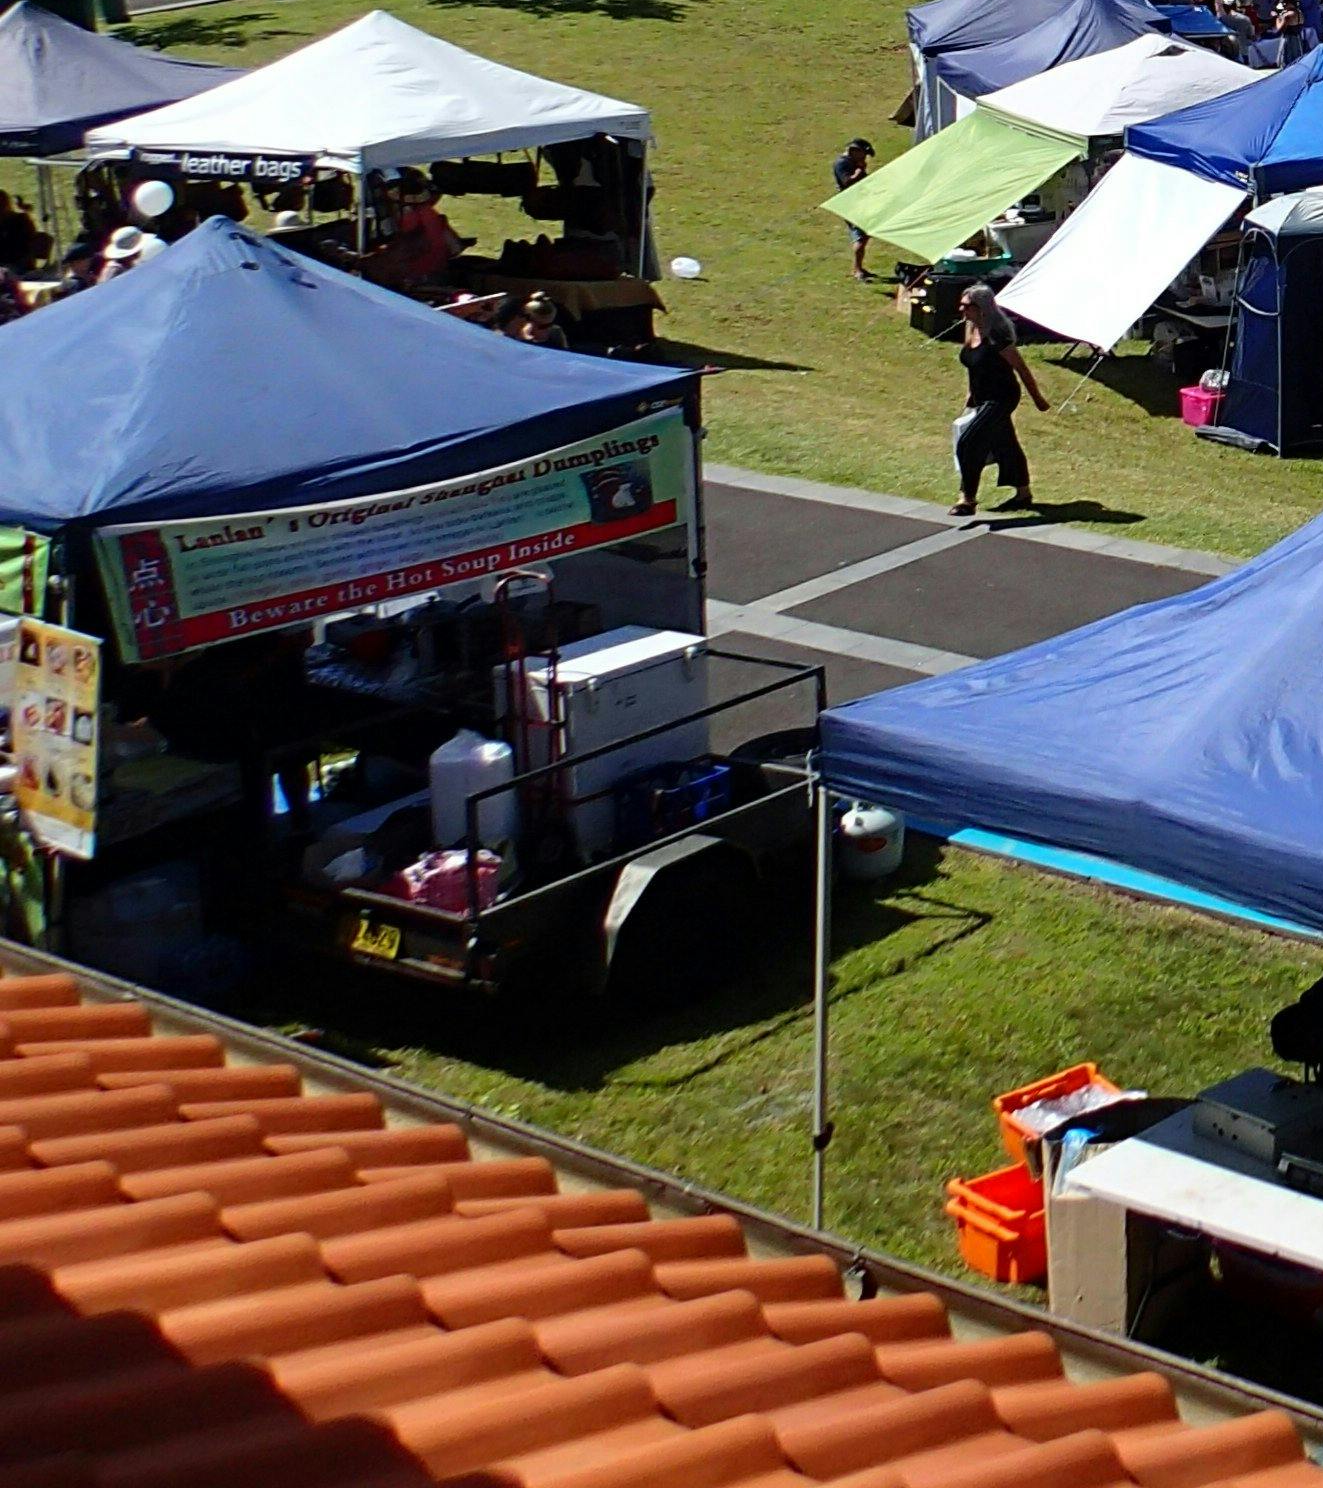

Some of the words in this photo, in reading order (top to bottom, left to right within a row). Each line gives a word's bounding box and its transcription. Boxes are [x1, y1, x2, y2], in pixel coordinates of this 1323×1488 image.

[181, 153, 252, 175] leather
[254, 156, 303, 182] bags
[308, 496, 415, 528] Original
[533, 432, 660, 478] Dumplings
[228, 593, 329, 629] Beware
[337, 578, 378, 602] the
[386, 568, 433, 592] Hot
[441, 553, 501, 578] Soup
[508, 532, 576, 562] Inside
